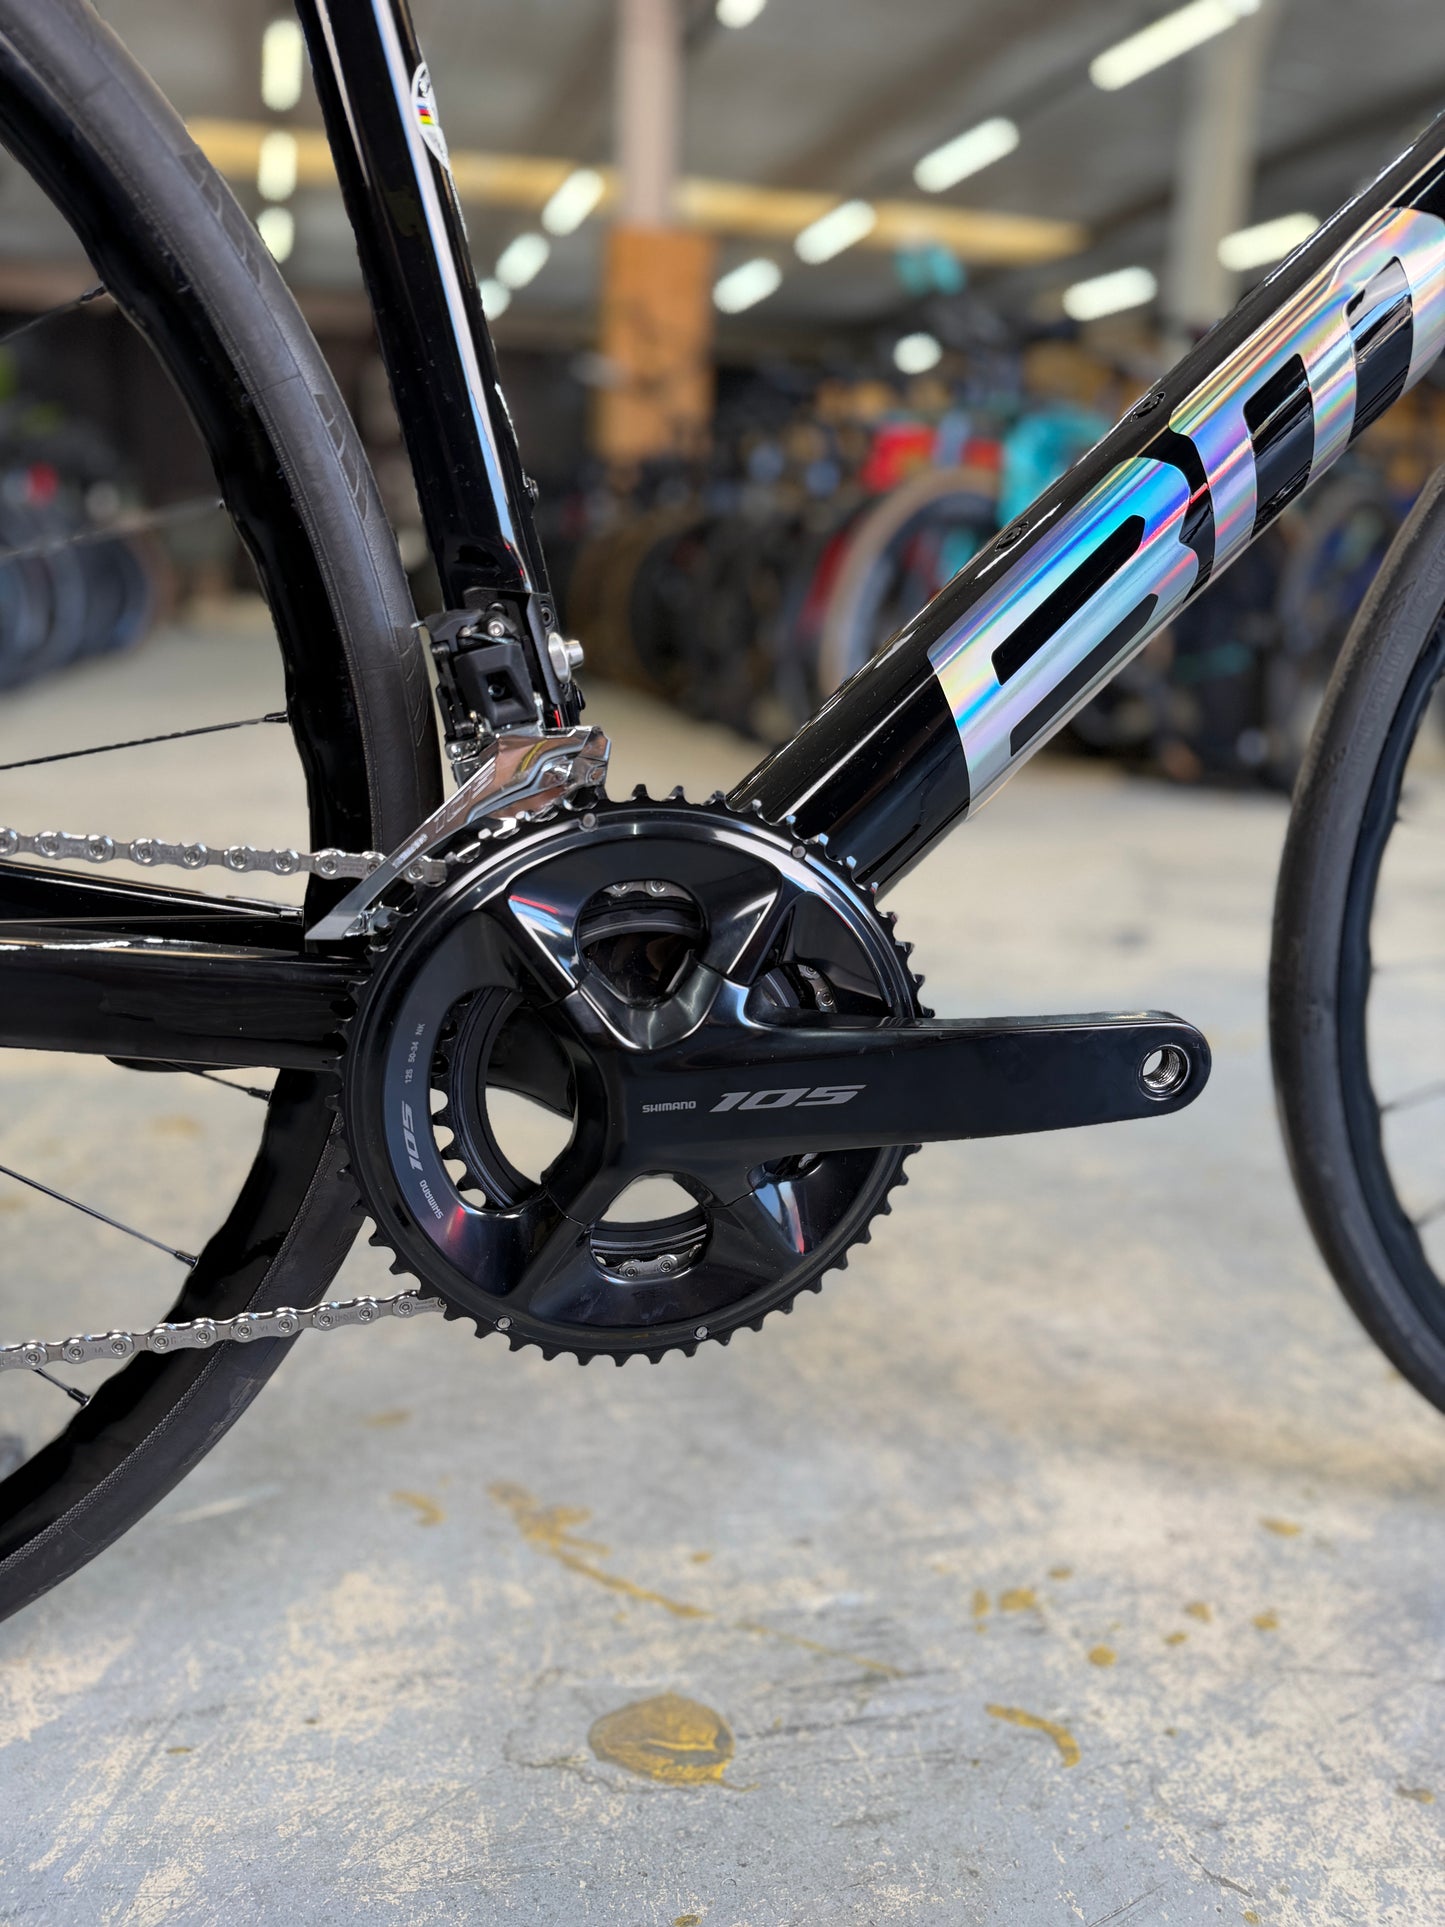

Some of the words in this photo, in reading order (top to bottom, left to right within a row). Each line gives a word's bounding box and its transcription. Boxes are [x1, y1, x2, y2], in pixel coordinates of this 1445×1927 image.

[415, 1023, 425, 1036] NK
[408, 1041, 419, 1063] 50-34
[405, 1068, 413, 1084] 12S
[642, 1100, 697, 1113] SHIMANO
[708, 1084, 868, 1113] 105
[401, 1100, 424, 1172] 105
[419, 1179, 444, 1220] SHIMANO
